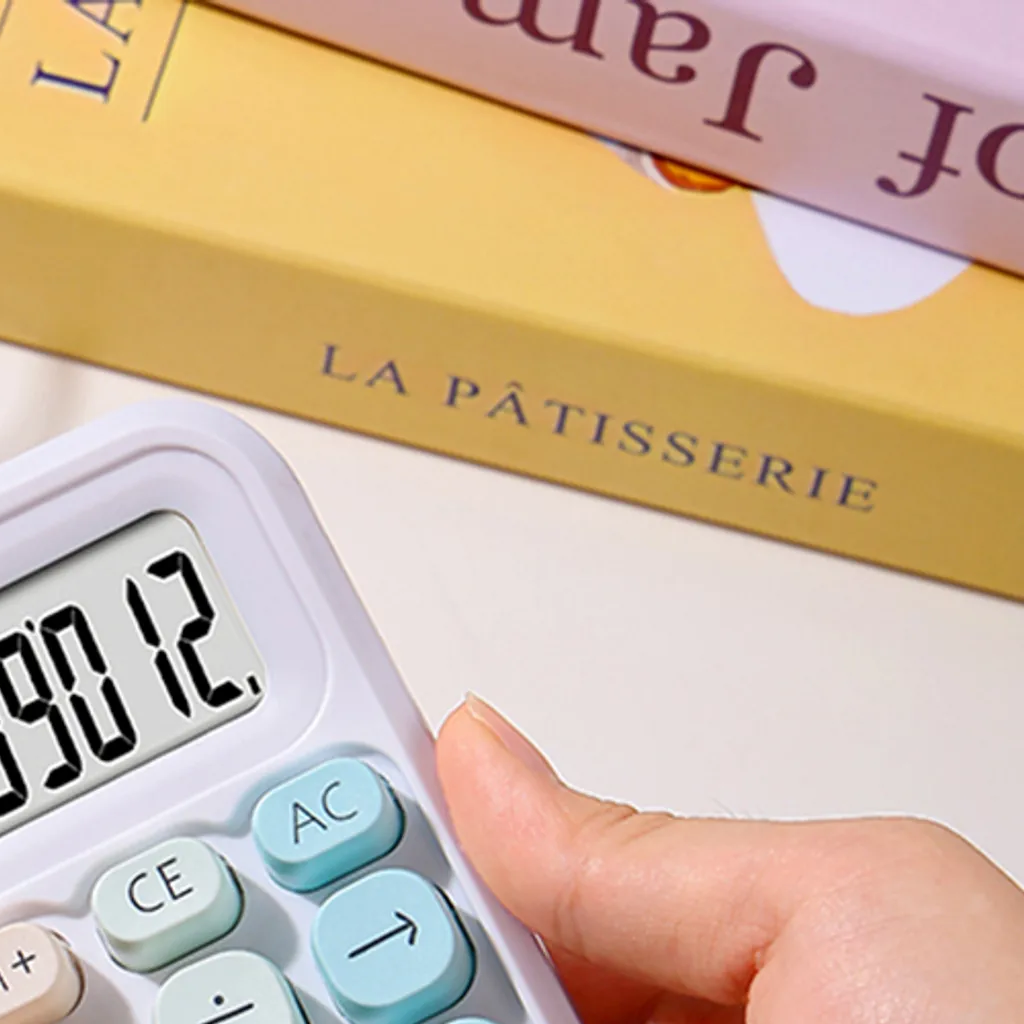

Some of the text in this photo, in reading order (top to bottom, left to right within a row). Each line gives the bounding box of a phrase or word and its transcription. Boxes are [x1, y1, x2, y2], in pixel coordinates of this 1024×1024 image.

[321, 343, 879, 513] LA PÂTISSERIE
[290, 781, 359, 844] AC
[127, 857, 193, 914] CE
